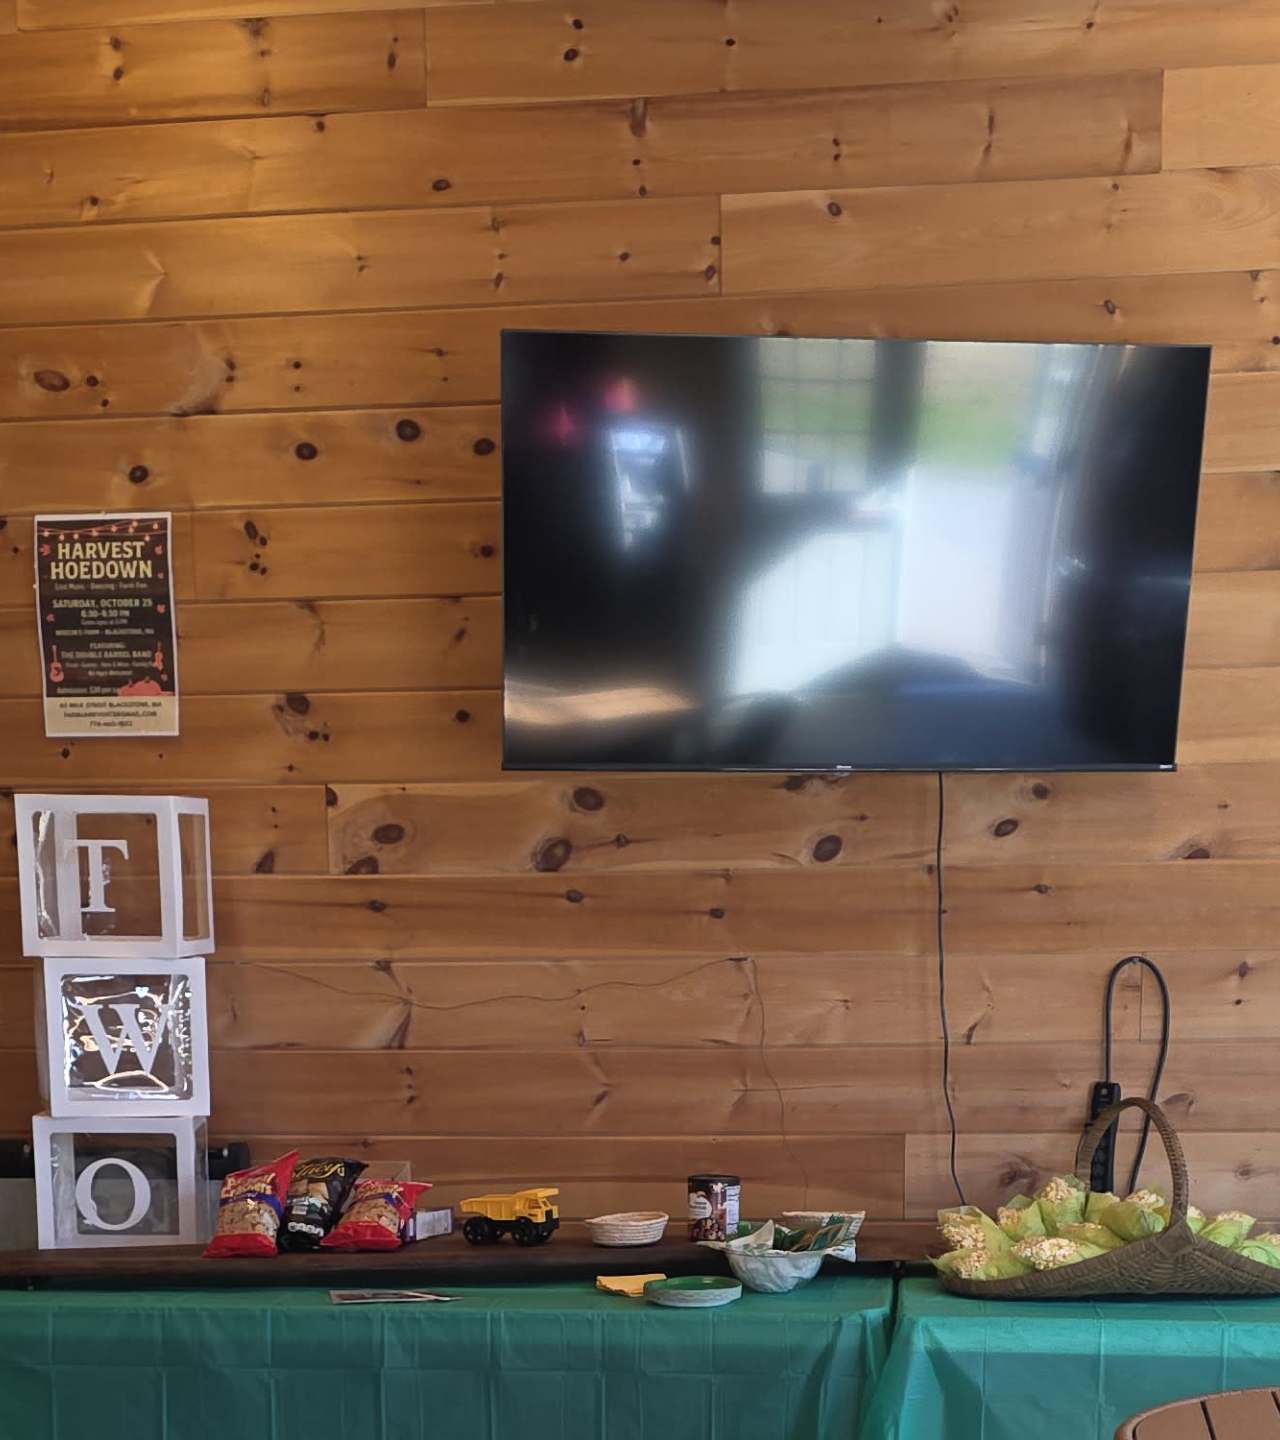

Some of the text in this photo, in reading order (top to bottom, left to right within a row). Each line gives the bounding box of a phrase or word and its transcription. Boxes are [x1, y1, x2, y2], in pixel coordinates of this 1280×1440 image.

[57, 541, 144, 560] HARVEST
[50, 560, 153, 580] HOEDOWN
[100, 598, 140, 608] OCTOBER
